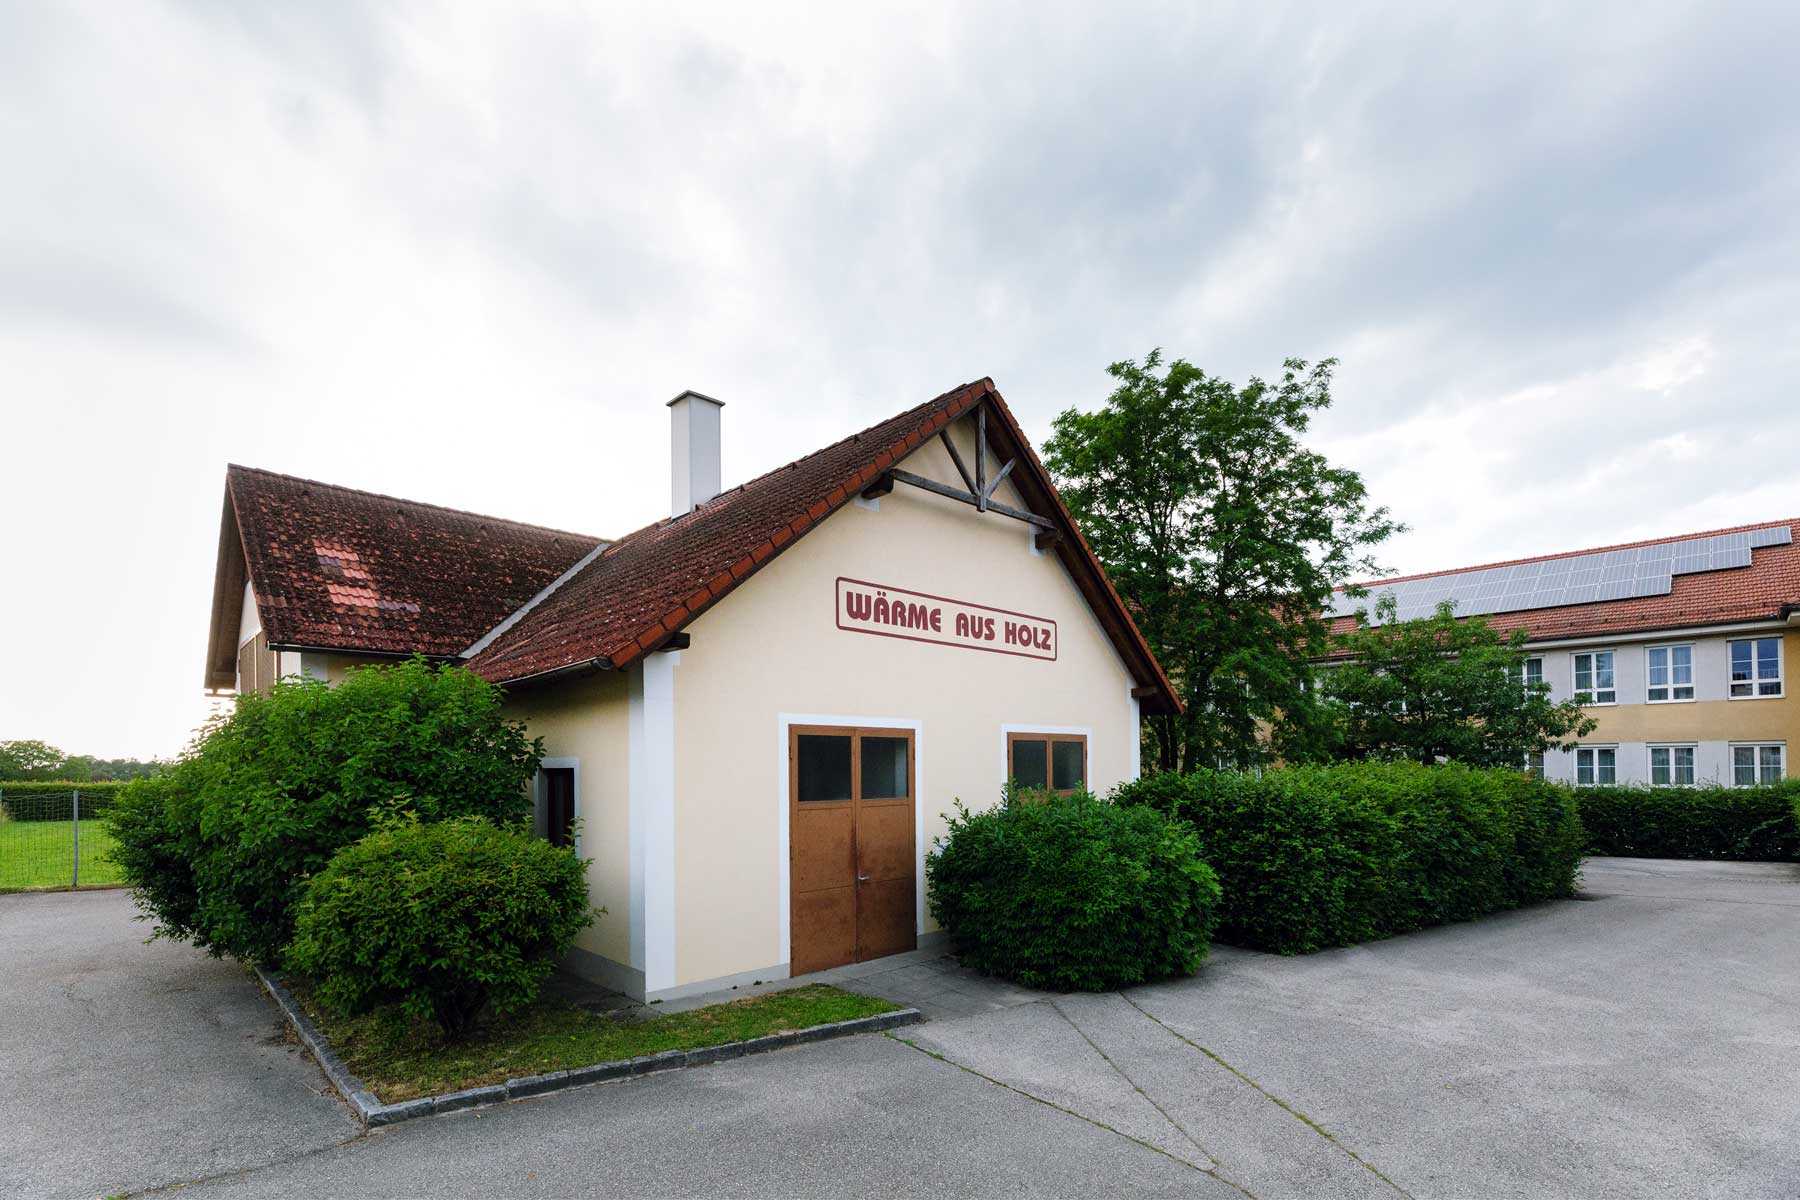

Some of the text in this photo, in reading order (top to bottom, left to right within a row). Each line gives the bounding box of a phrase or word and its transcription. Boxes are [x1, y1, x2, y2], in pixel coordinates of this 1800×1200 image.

[846, 591, 1051, 651] WÄRME AUS HOLZ
